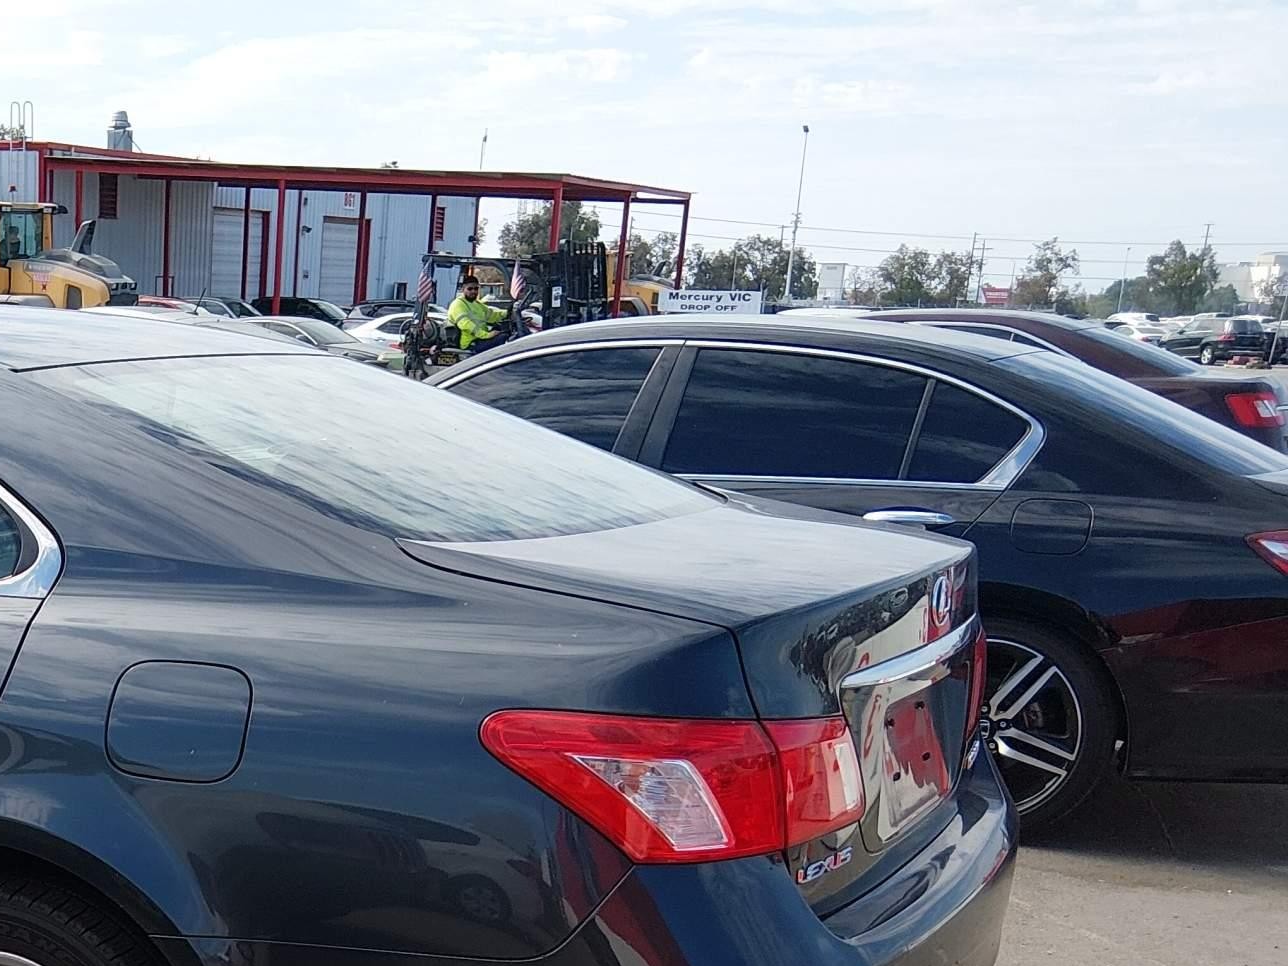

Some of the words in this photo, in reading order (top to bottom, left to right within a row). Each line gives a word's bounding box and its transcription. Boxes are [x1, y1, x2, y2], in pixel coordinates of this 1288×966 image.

[668, 292, 723, 303] Mercury
[729, 293, 752, 302] VIC
[715, 304, 738, 312] OFF
[797, 846, 853, 885] LEXUS
